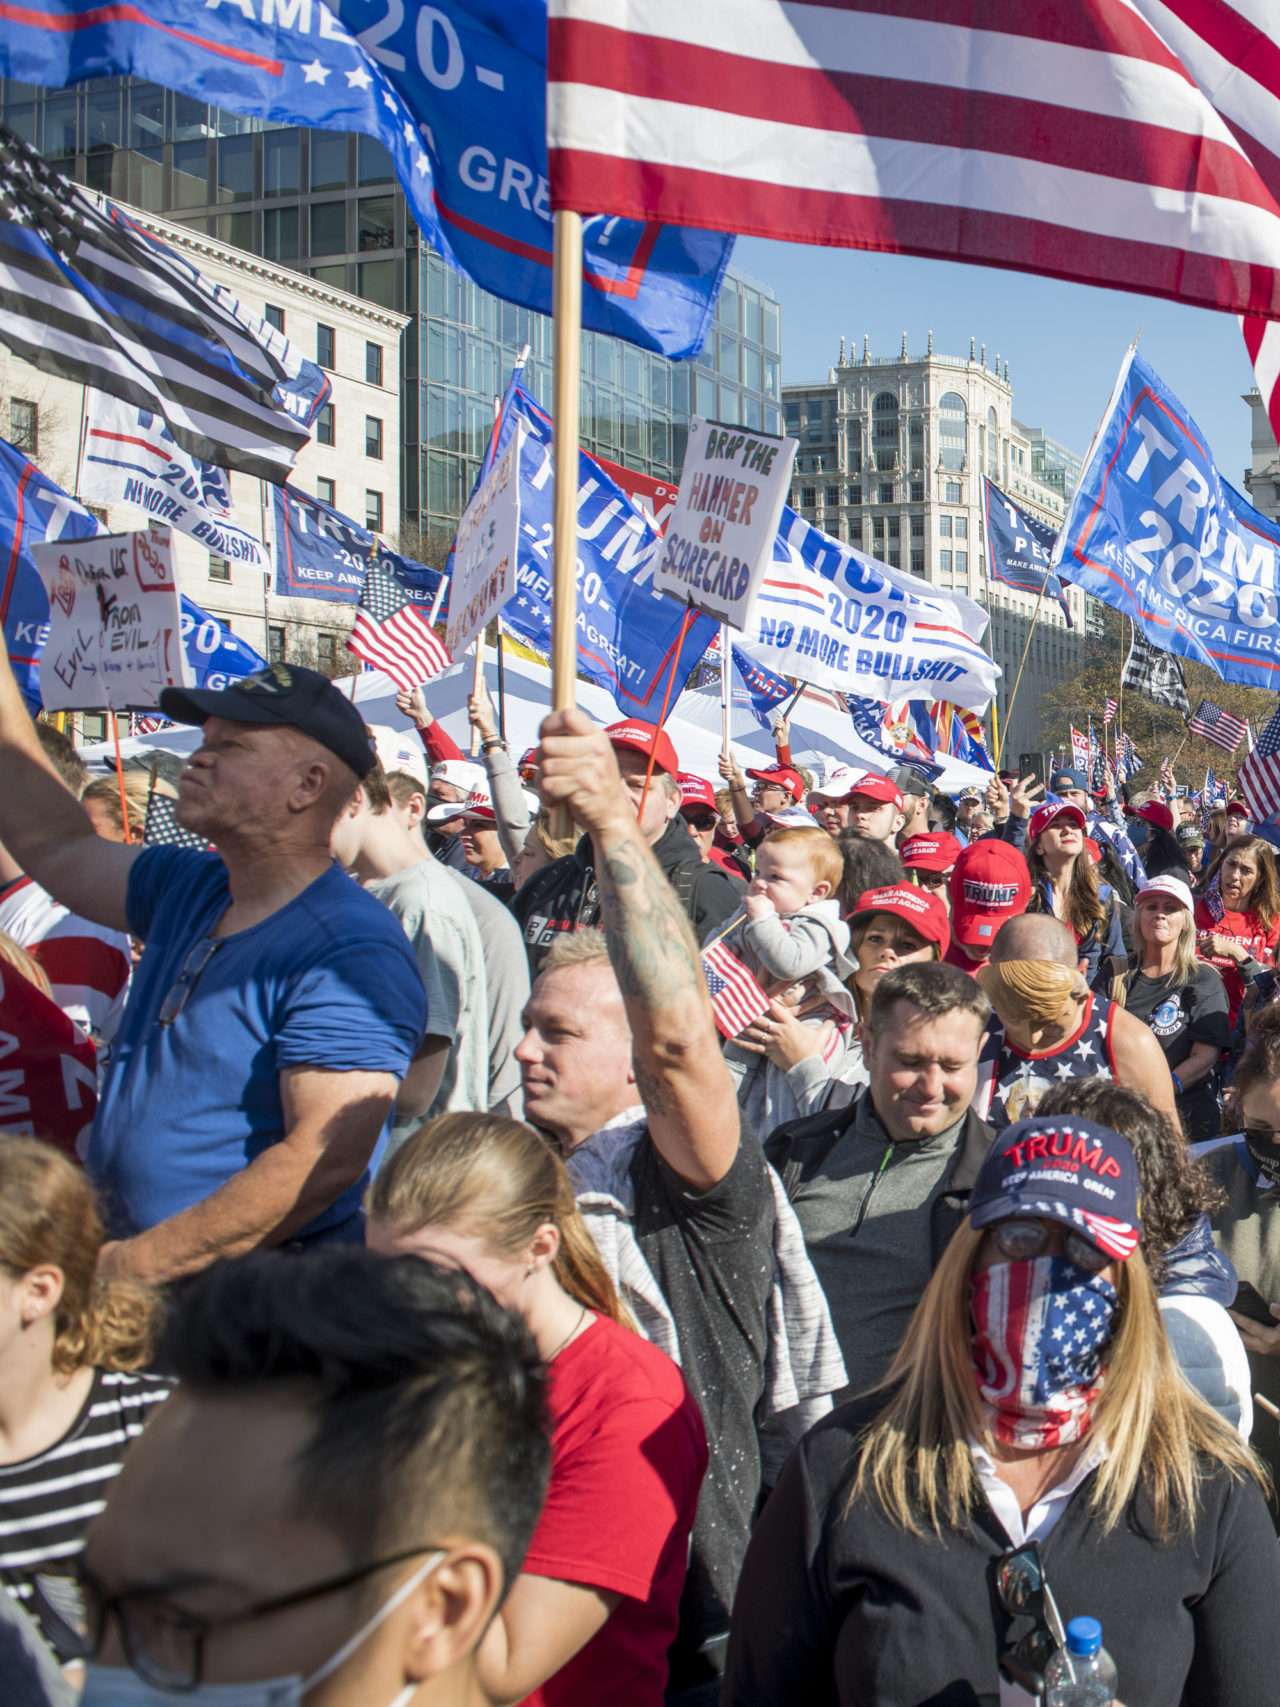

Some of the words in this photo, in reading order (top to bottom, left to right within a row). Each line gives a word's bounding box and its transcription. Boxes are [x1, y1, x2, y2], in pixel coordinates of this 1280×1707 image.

[741, 439, 779, 477] THE
[699, 515, 726, 544] ON
[296, 566, 334, 582] KEEP
[662, 533, 751, 602] SCORECARD
[827, 592, 908, 645] 2020
[1134, 582, 1234, 645] AMERICA
[585, 630, 647, 685] GREAT!
[758, 616, 794, 648] NO
[796, 626, 849, 673] MORE
[854, 651, 969, 685] BULLSHIT
[1002, 1132, 1121, 1178] TRUMP
[1028, 1169, 1079, 1185] AMERICA
[1082, 1177, 1117, 1201] GREAT
